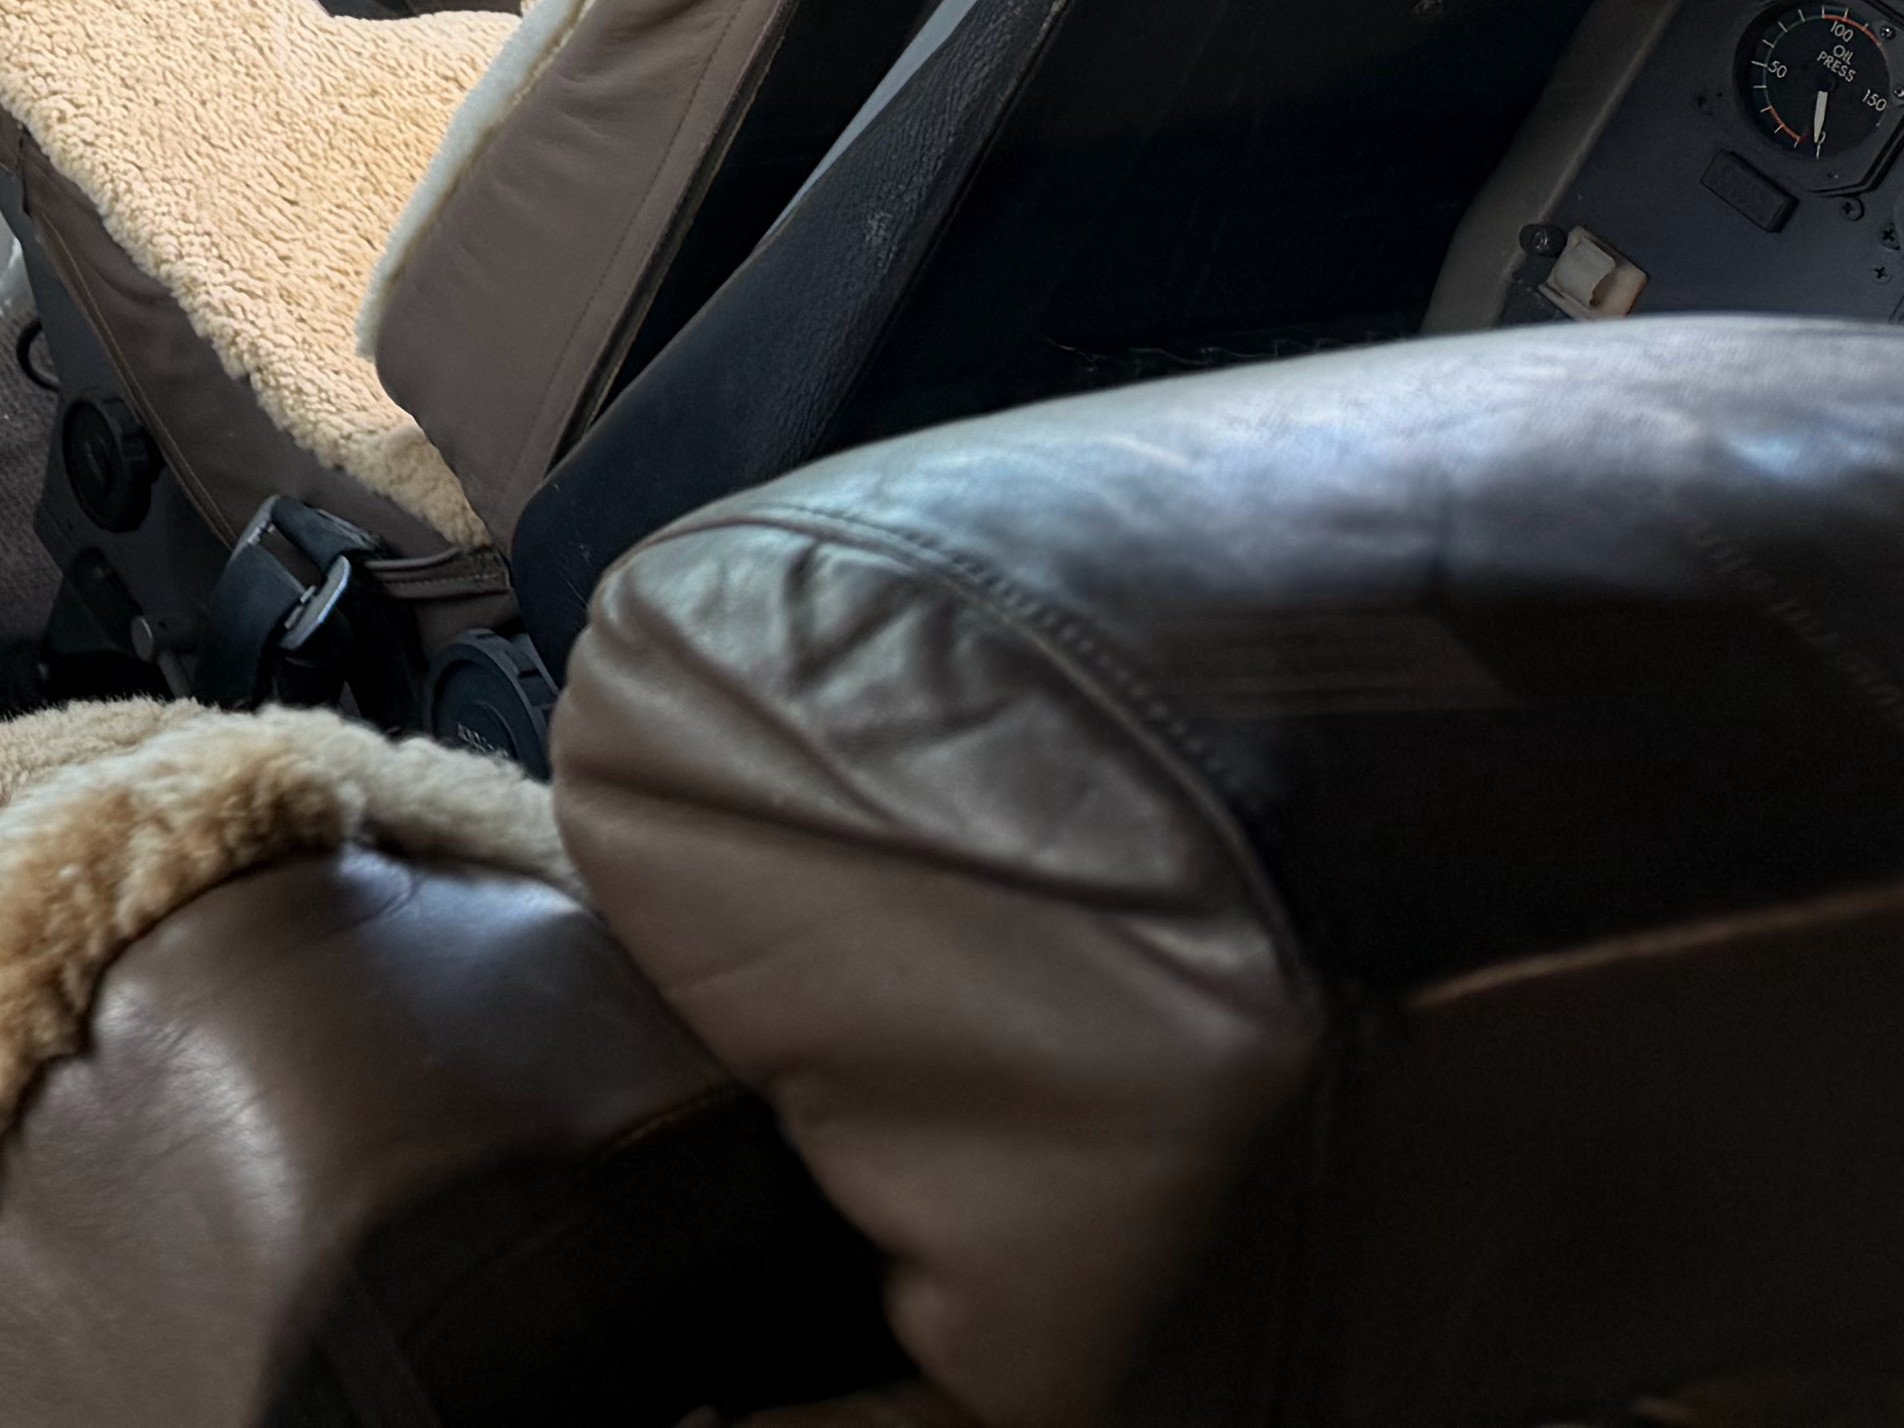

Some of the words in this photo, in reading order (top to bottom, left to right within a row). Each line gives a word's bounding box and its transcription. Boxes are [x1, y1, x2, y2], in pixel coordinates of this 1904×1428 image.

[1830, 21, 1852, 43] 100
[1833, 44, 1853, 65] OIL
[1768, 60, 1788, 79] 50
[1817, 51, 1856, 82] PRESS
[1862, 89, 1887, 111] 150
